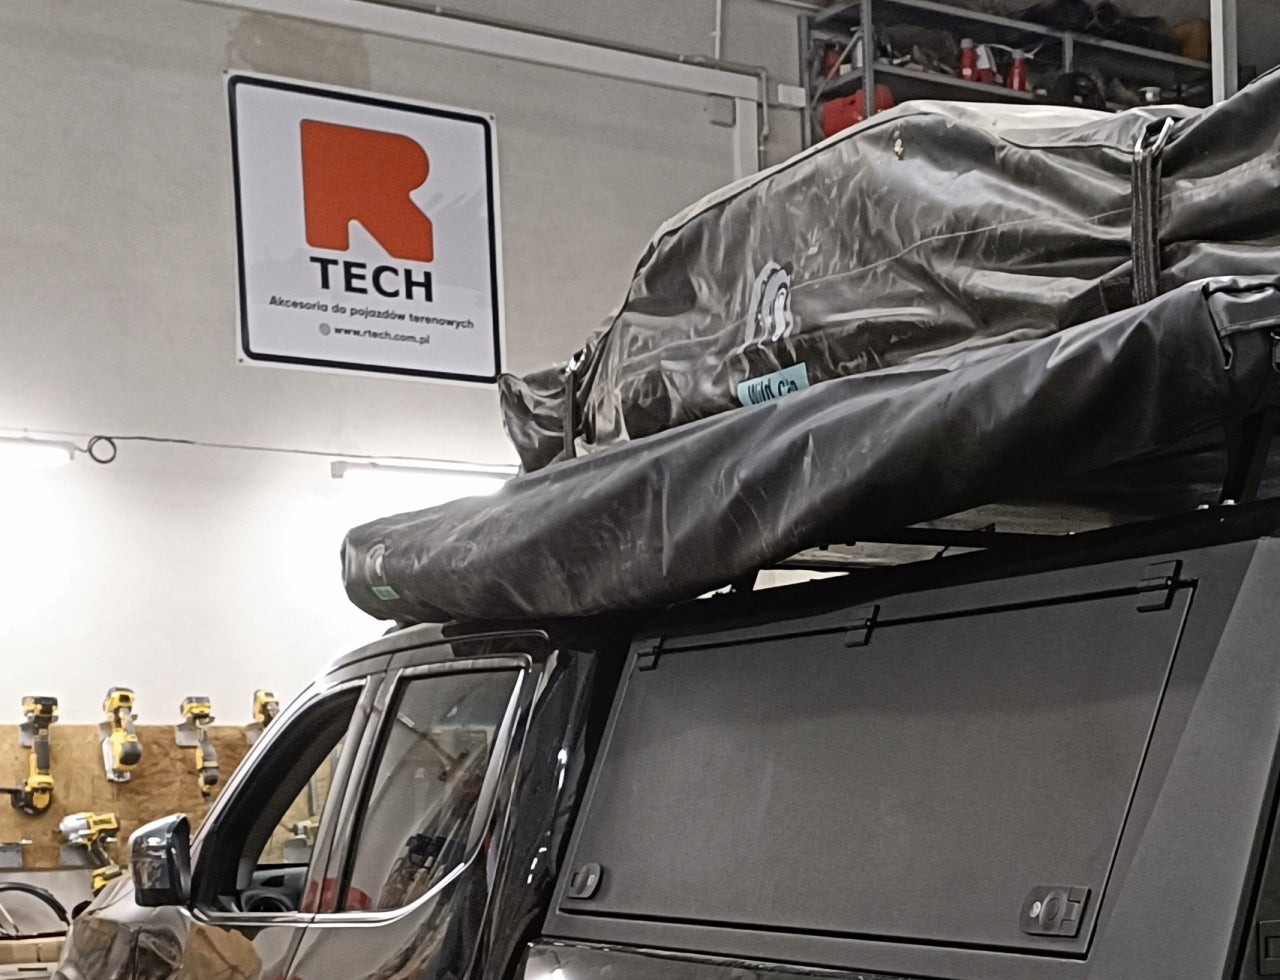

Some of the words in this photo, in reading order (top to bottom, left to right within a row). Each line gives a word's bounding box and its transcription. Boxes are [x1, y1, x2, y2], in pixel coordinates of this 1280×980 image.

[309, 256, 433, 302] TECH
[269, 295, 328, 312] Akcesoria
[331, 303, 347, 314] do
[350, 306, 406, 320] pojazdów
[409, 313, 474, 329] terenowych
[334, 327, 431, 345] www.rtech.com.pl
